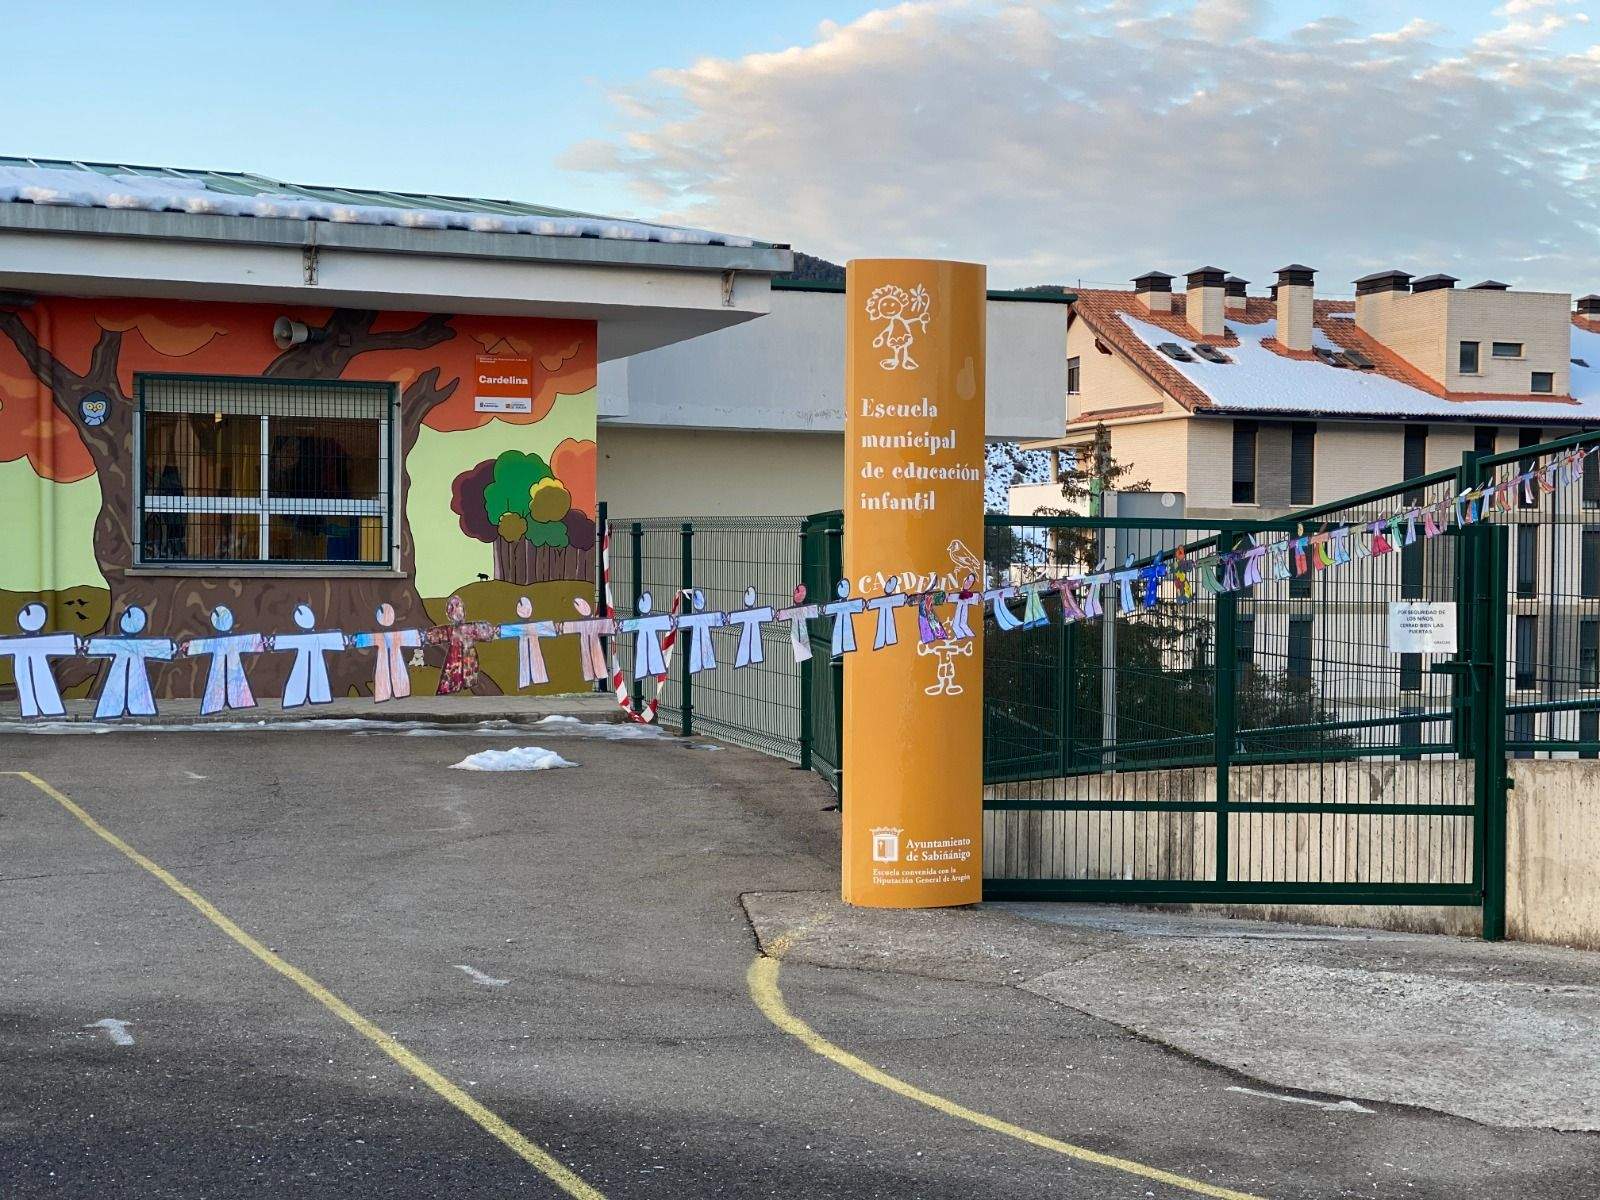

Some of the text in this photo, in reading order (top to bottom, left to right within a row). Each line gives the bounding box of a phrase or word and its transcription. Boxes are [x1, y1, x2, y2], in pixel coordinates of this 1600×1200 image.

[479, 375, 528, 385] Cardelina
[860, 398, 938, 418] Escuela
[861, 429, 956, 455] municipal
[860, 462, 980, 481] de educación
[860, 491, 935, 510] infantil
[906, 837, 971, 852] Ayuntamiento
[906, 849, 971, 862] de Sabiñánigo
[873, 868, 900, 876] Escuela
[901, 867, 937, 876] convenida
[950, 866, 957, 874] la
[873, 876, 914, 886] Diputación
[915, 875, 941, 884] General
[943, 875, 950, 883] de
